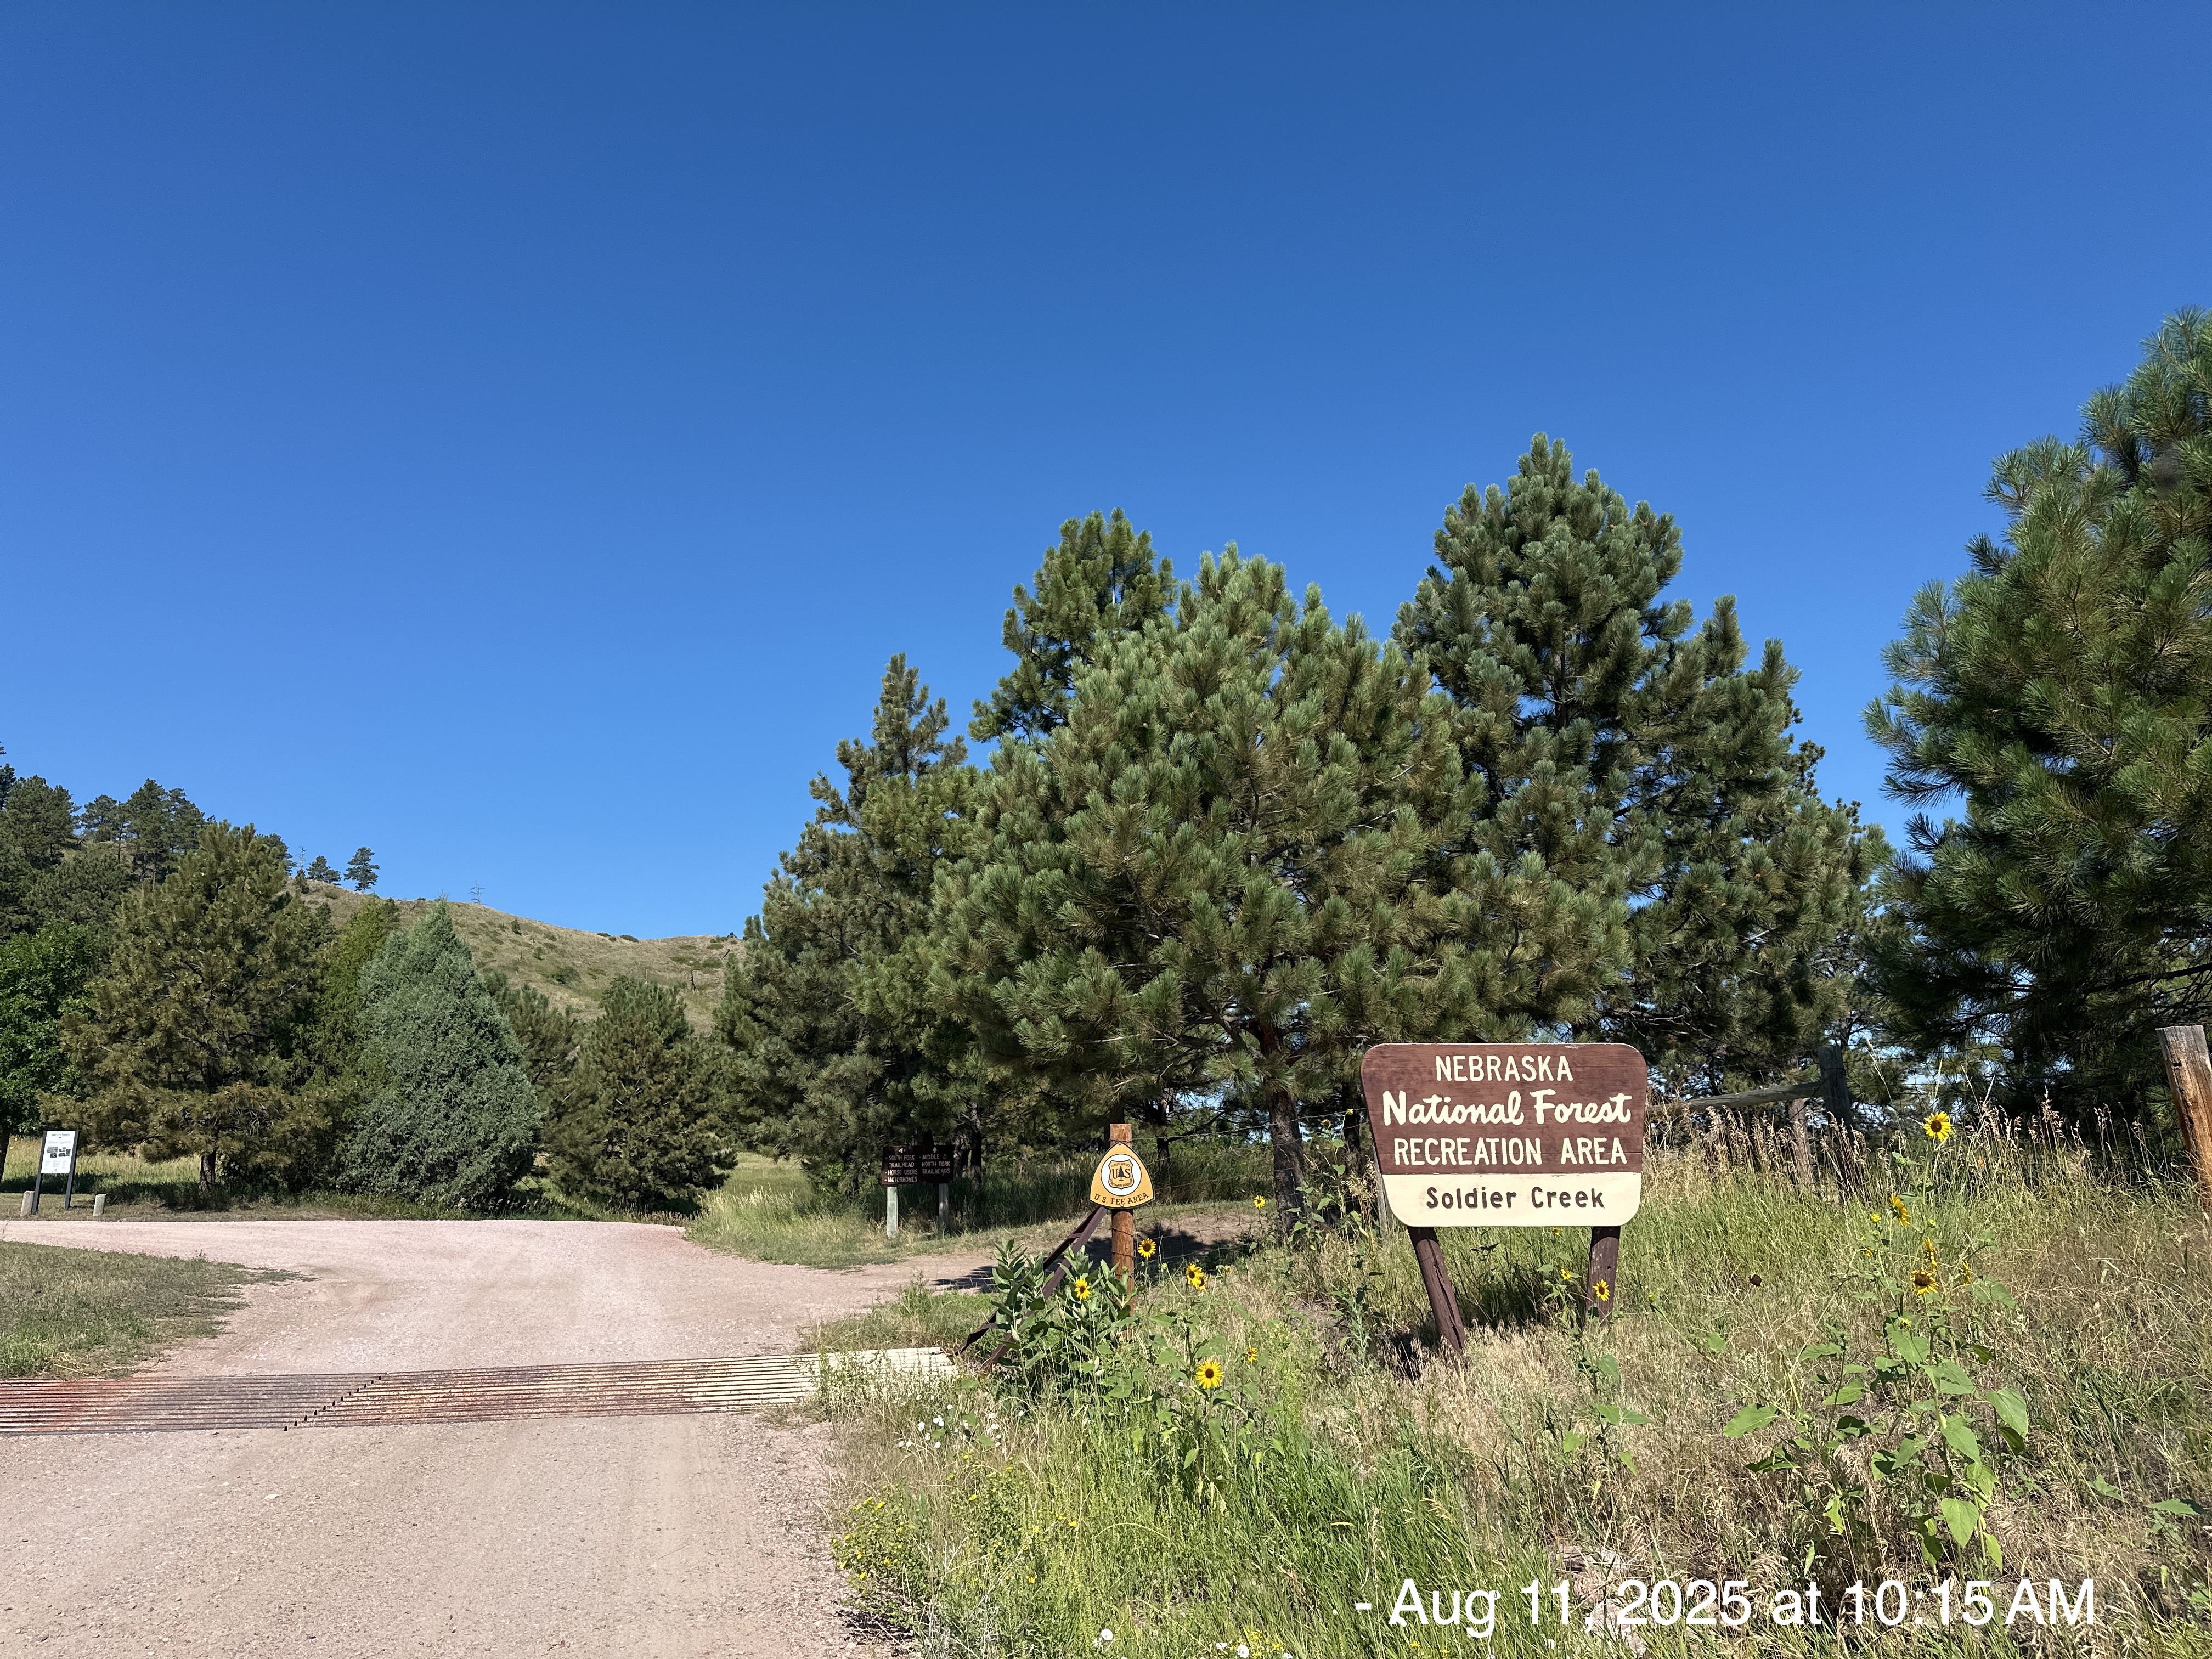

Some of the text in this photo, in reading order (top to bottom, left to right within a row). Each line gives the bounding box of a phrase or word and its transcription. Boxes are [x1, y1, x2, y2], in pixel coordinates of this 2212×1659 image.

[1435, 1054, 1573, 1082] NEBRASKA
[1383, 1088, 1633, 1126] National Forest
[1394, 1137, 1628, 1166] RECREATION AREA
[1128, 1192, 1149, 1204] AREA
[1426, 1186, 1605, 1209] Soldier Creek
